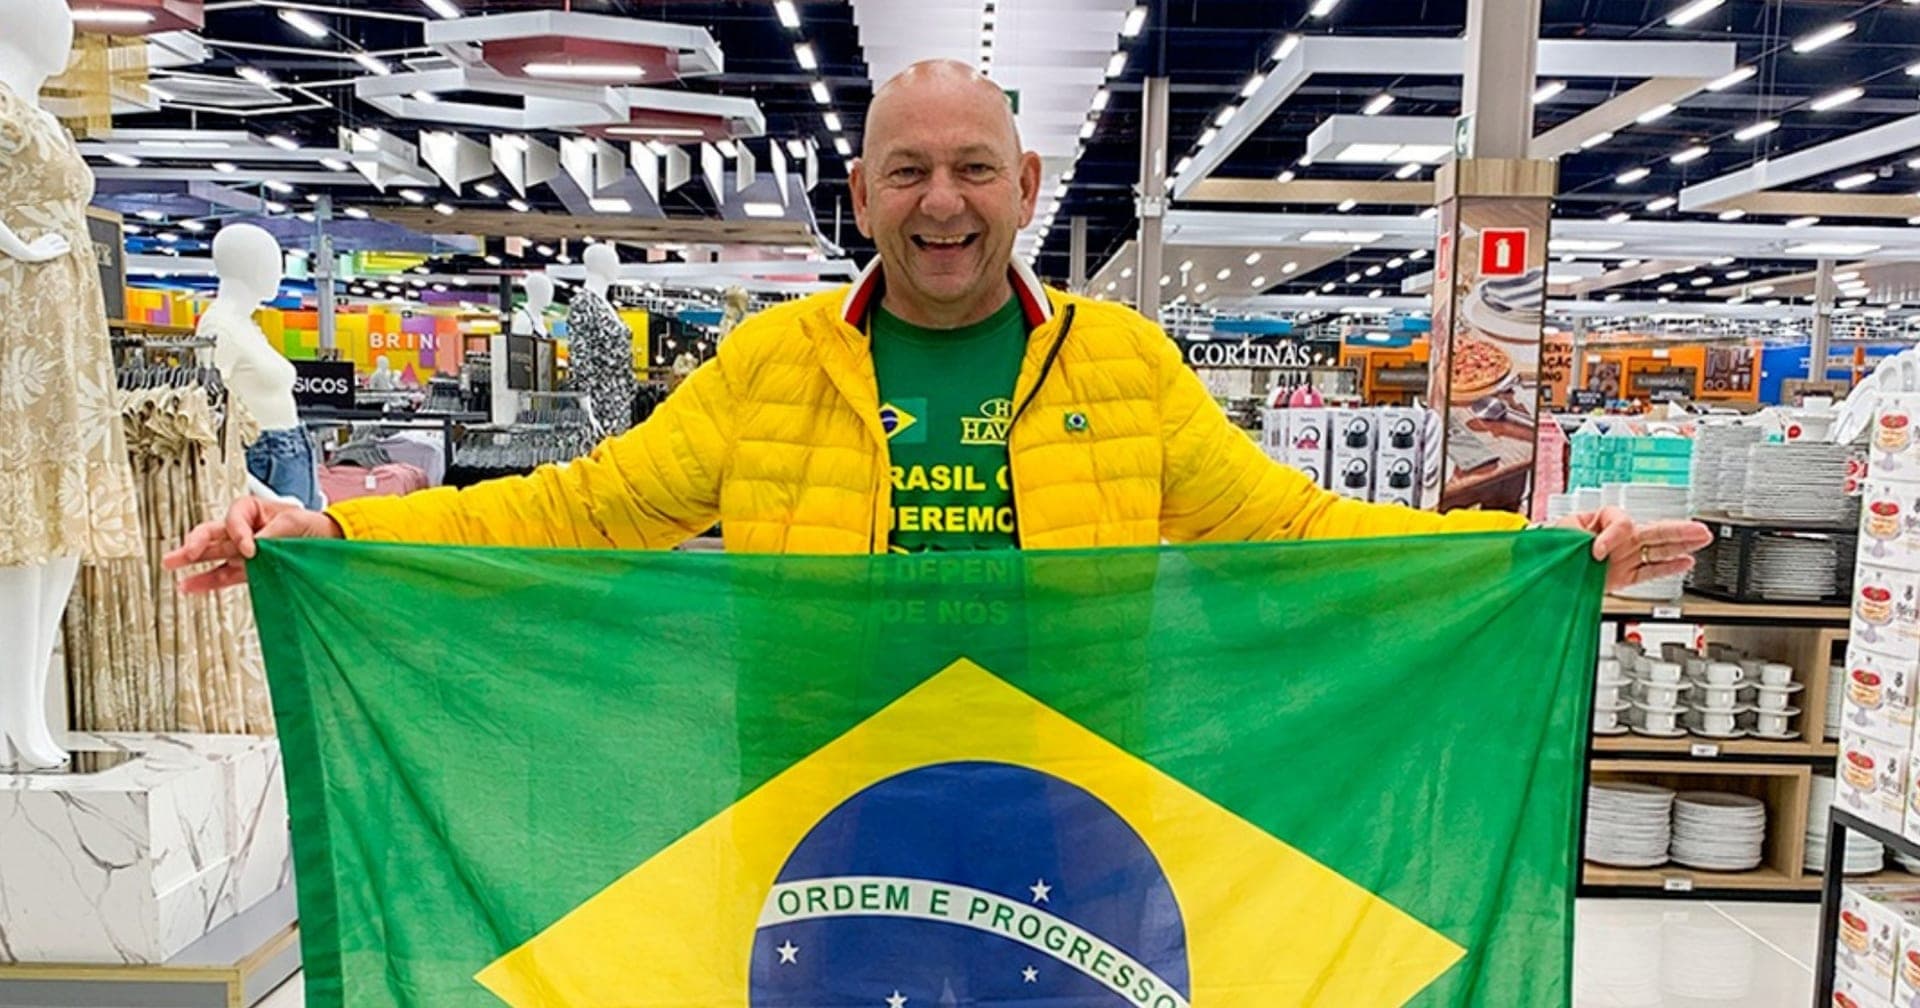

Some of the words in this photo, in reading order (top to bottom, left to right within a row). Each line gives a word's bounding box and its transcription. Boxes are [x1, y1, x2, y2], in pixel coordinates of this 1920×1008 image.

[370, 332, 440, 349] BRIN
[1188, 342, 1311, 367] CORTINAS
[889, 506, 1014, 533] EREMO
[778, 883, 910, 915] ORDEM
[929, 889, 950, 915] E
